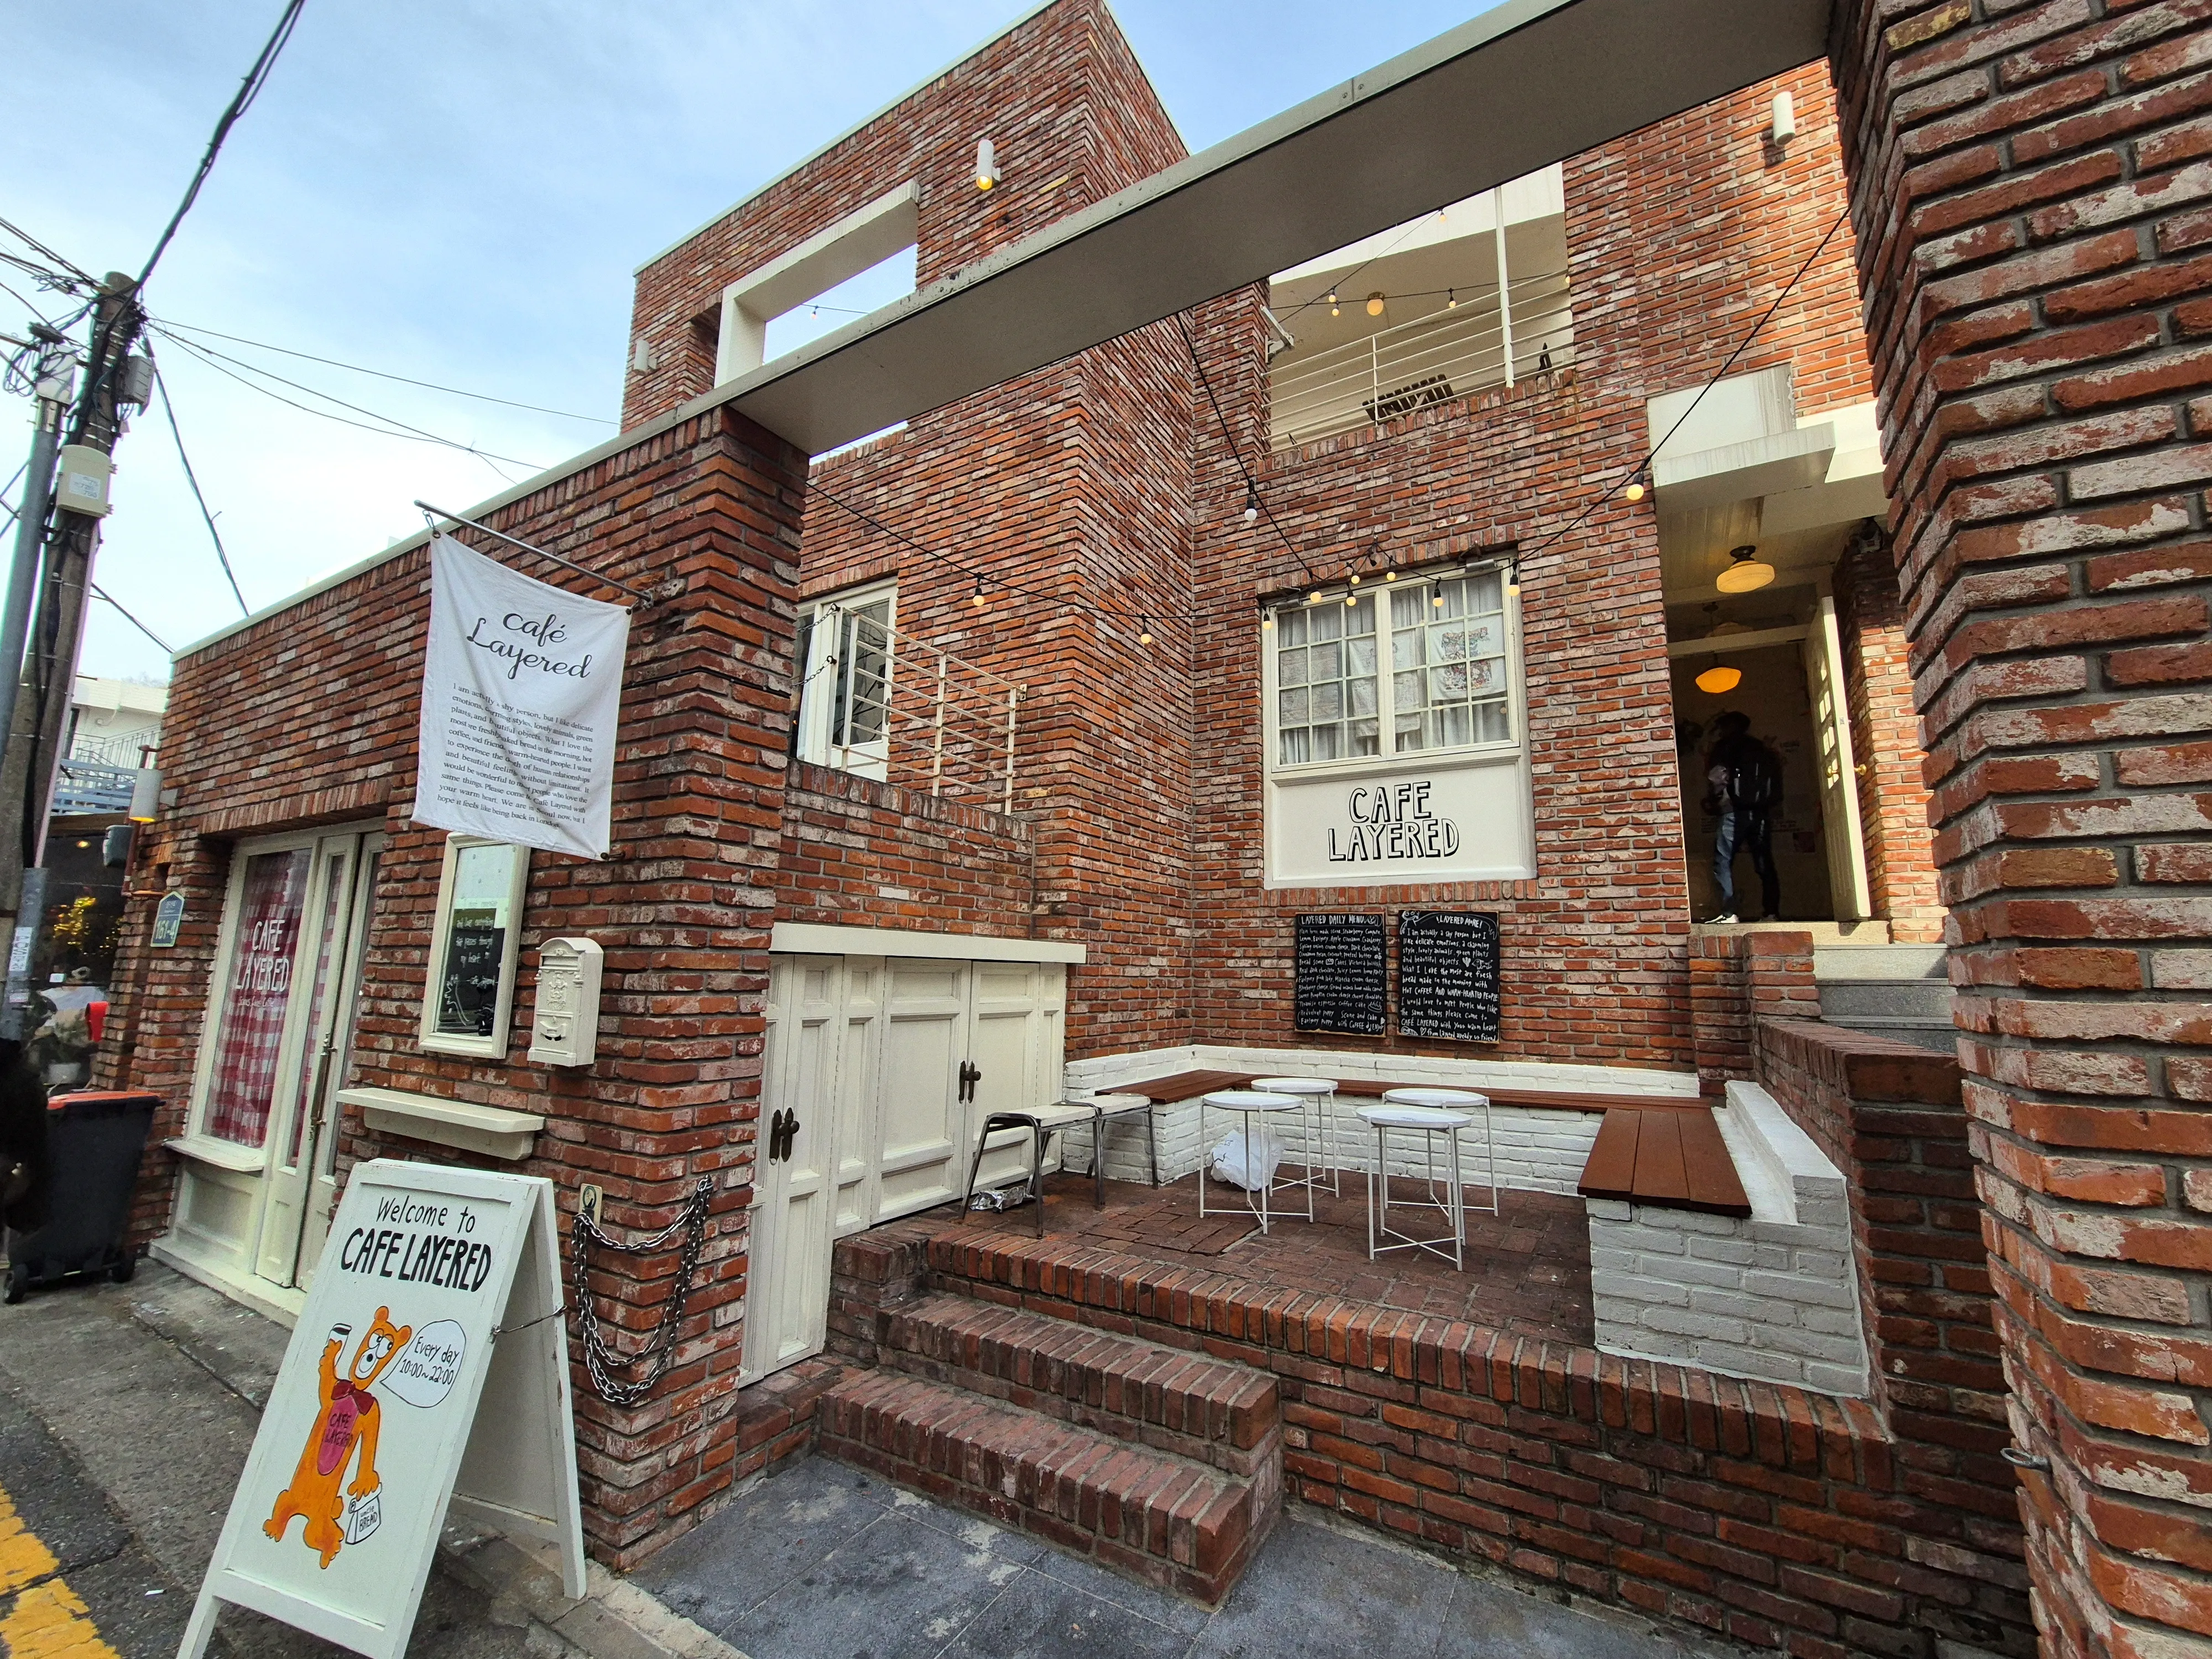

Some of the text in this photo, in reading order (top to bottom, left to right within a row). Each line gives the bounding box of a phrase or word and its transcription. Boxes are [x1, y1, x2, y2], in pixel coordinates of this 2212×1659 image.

[503, 613, 567, 647] Café
[467, 618, 592, 679] Layered
[452, 696, 483, 710] emotions,
[534, 722, 552, 733] lovely
[571, 722, 593, 732] delicate
[450, 718, 466, 726] most
[520, 740, 536, 749] bread
[554, 751, 581, 761] morning,
[545, 736, 560, 745] What
[457, 743, 490, 757] experience
[533, 765, 551, 775] human
[553, 771, 589, 784] relationships
[509, 750, 549, 764] warm-hearted
[444, 763, 465, 771] would
[476, 771, 507, 783] wonderful
[521, 775, 546, 784] without
[460, 789, 480, 798] warm
[484, 784, 504, 793] Please
[551, 801, 571, 810] Layered
[437, 794, 455, 804] hope
[463, 800, 478, 808] feels
[493, 808, 509, 818] being
[512, 812, 526, 820] back
[1349, 781, 1432, 823] CAFE
[1328, 818, 1459, 862] LAYERED
[1301, 915, 1364, 925] LAYERED DAILY MENU
[252, 920, 285, 952] CAFE
[1420, 929, 1438, 937] actually
[1415, 936, 1434, 945] delicate
[1467, 941, 1489, 950] charming
[1415, 955, 1436, 964] beautiful
[1418, 946, 1432, 955] lovely
[1473, 950, 1489, 958] plants
[236, 955, 289, 992] LAYERED
[1402, 974, 1416, 983] bread
[1419, 976, 1432, 984] made
[1476, 970, 1492, 980] fresh
[1435, 987, 1444, 995] AND
[1447, 988, 1482, 999] WARM-HEARTED
[1401, 997, 1404, 1005] I
[1407, 998, 1421, 1006] would
[1488, 1004, 1498, 1014] like
[1338, 1019, 1347, 1027] with
[1417, 1019, 1438, 1027] LAYERED
[1483, 1022, 1496, 1031] heart
[376, 1196, 475, 1233] Welcome to
[341, 1228, 491, 1292] CAFE LAYERED
[414, 1336, 460, 1367] Every day
[330, 1413, 352, 1428] CAFE
[361, 1506, 374, 1517] uncle
[359, 1512, 377, 1532] BREAD
